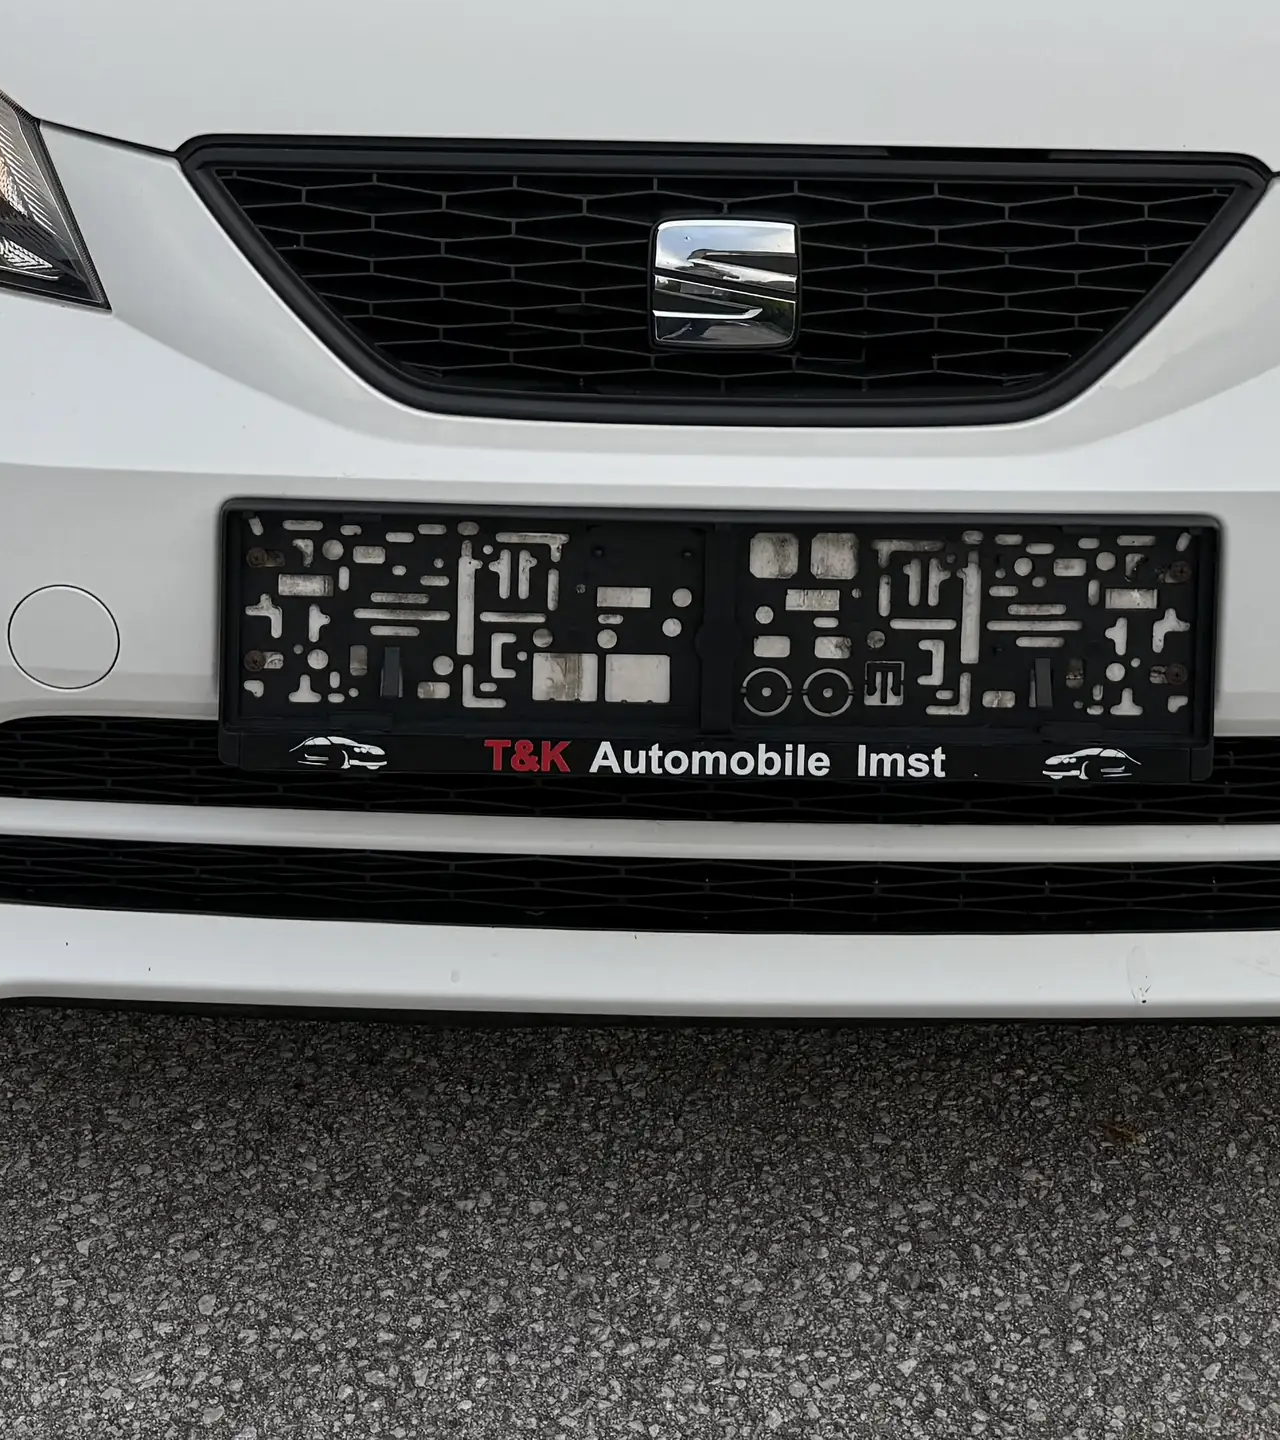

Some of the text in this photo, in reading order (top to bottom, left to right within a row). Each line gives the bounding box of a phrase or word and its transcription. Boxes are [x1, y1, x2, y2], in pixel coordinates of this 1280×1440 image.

[484, 739, 946, 778] T&K Automobile Imst
